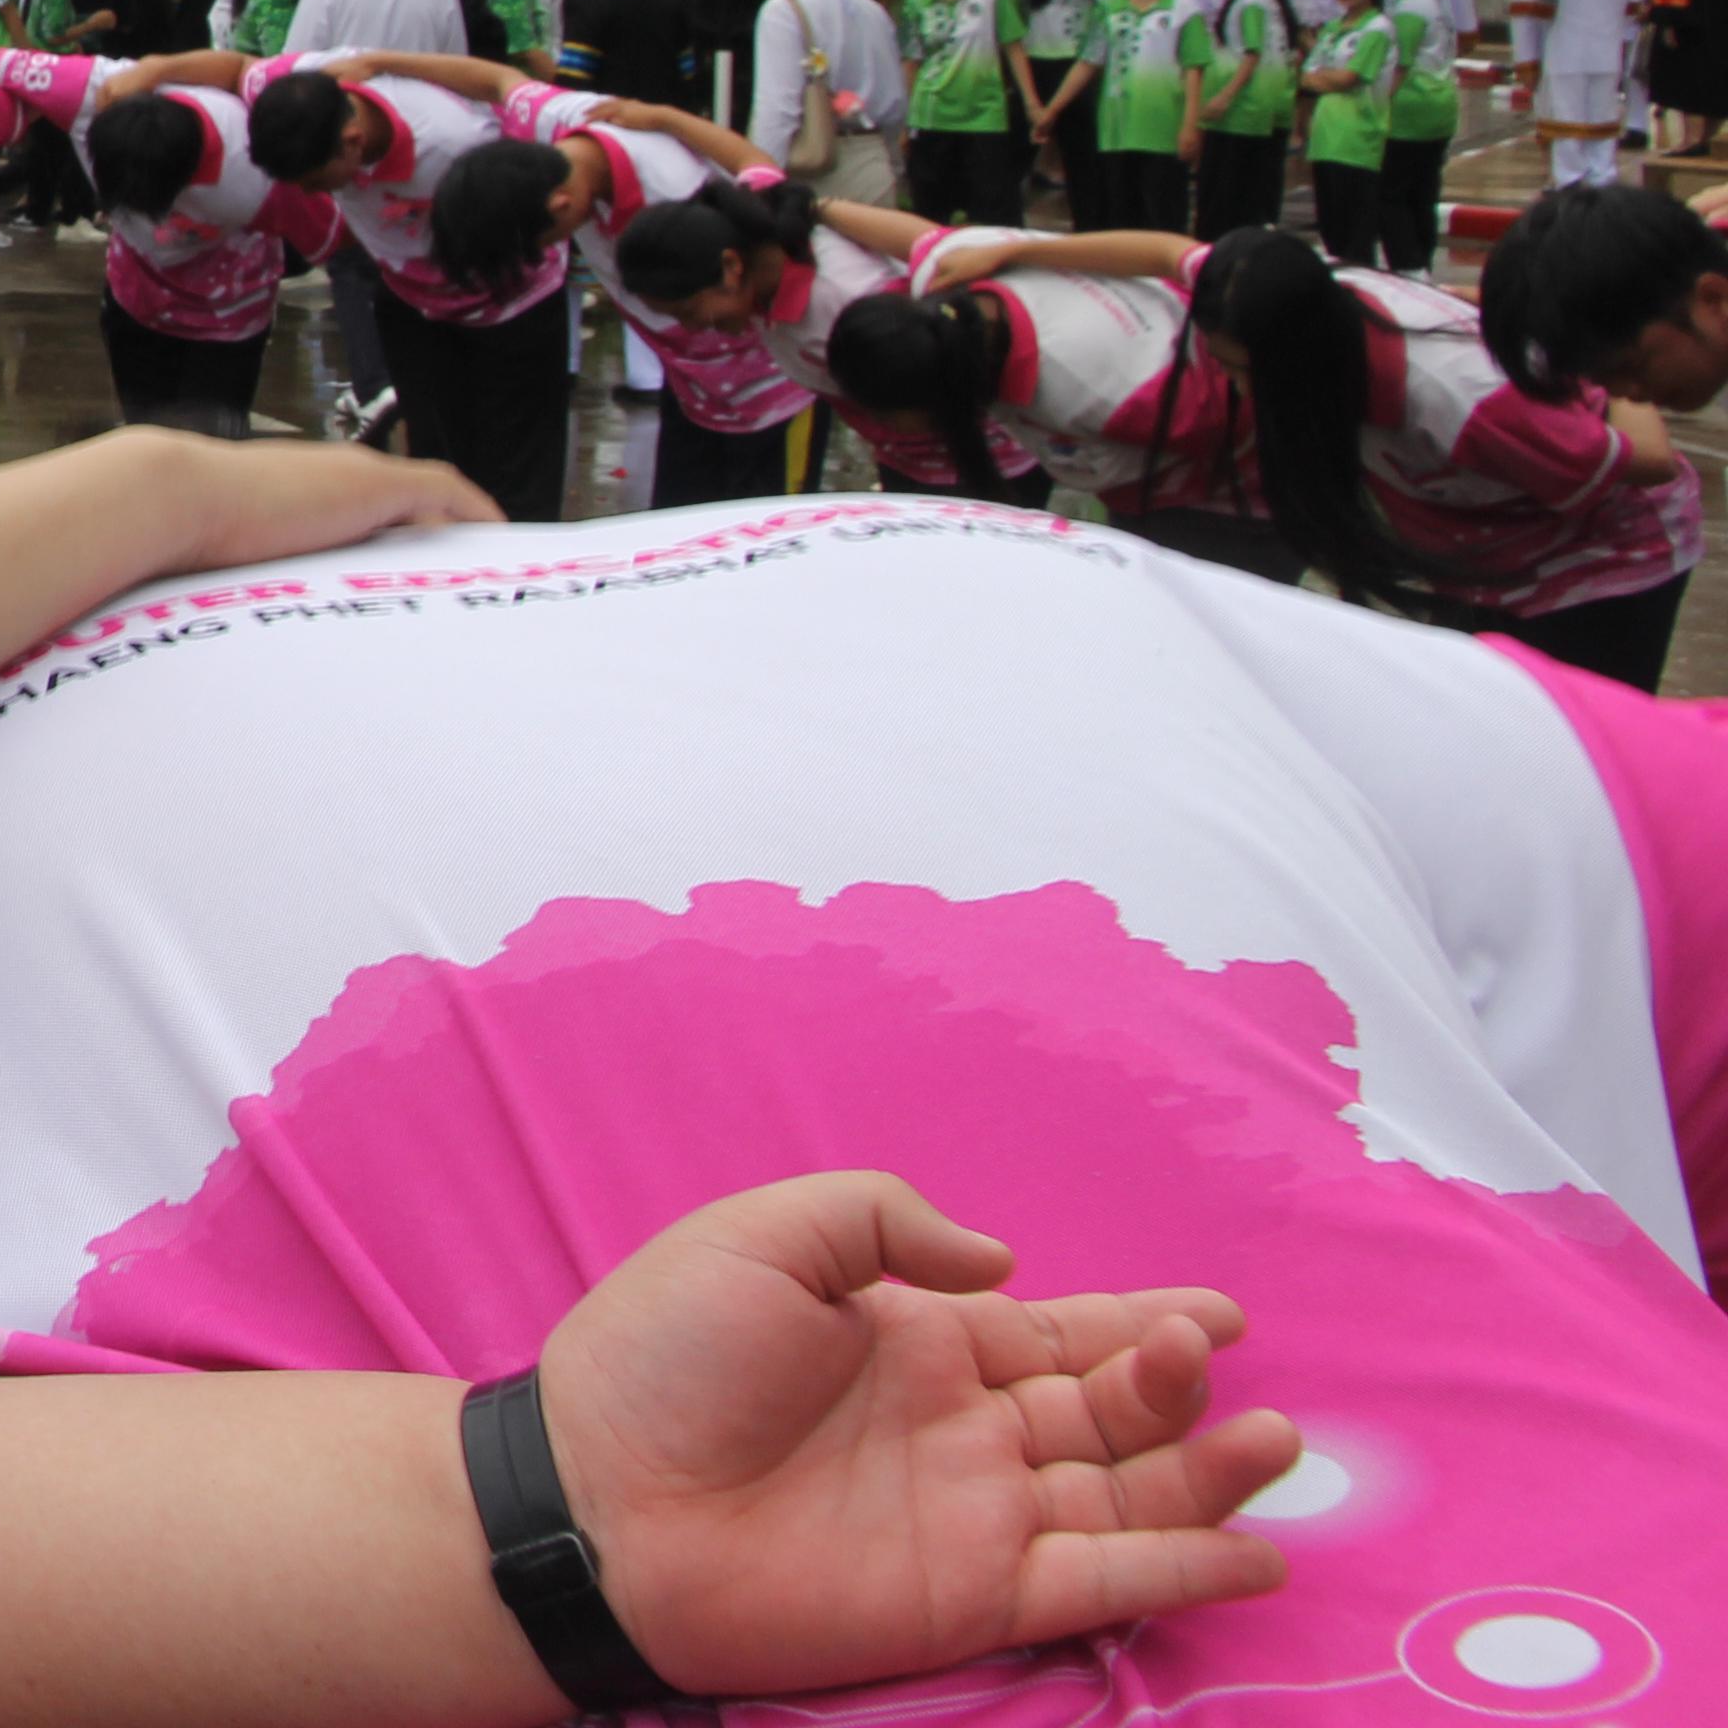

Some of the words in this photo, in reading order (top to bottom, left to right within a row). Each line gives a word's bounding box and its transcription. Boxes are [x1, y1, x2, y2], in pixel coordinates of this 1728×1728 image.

[24, 52, 60, 91] 68
[252, 593, 425, 626] PHET
[458, 534, 809, 610] RAJABHAT
